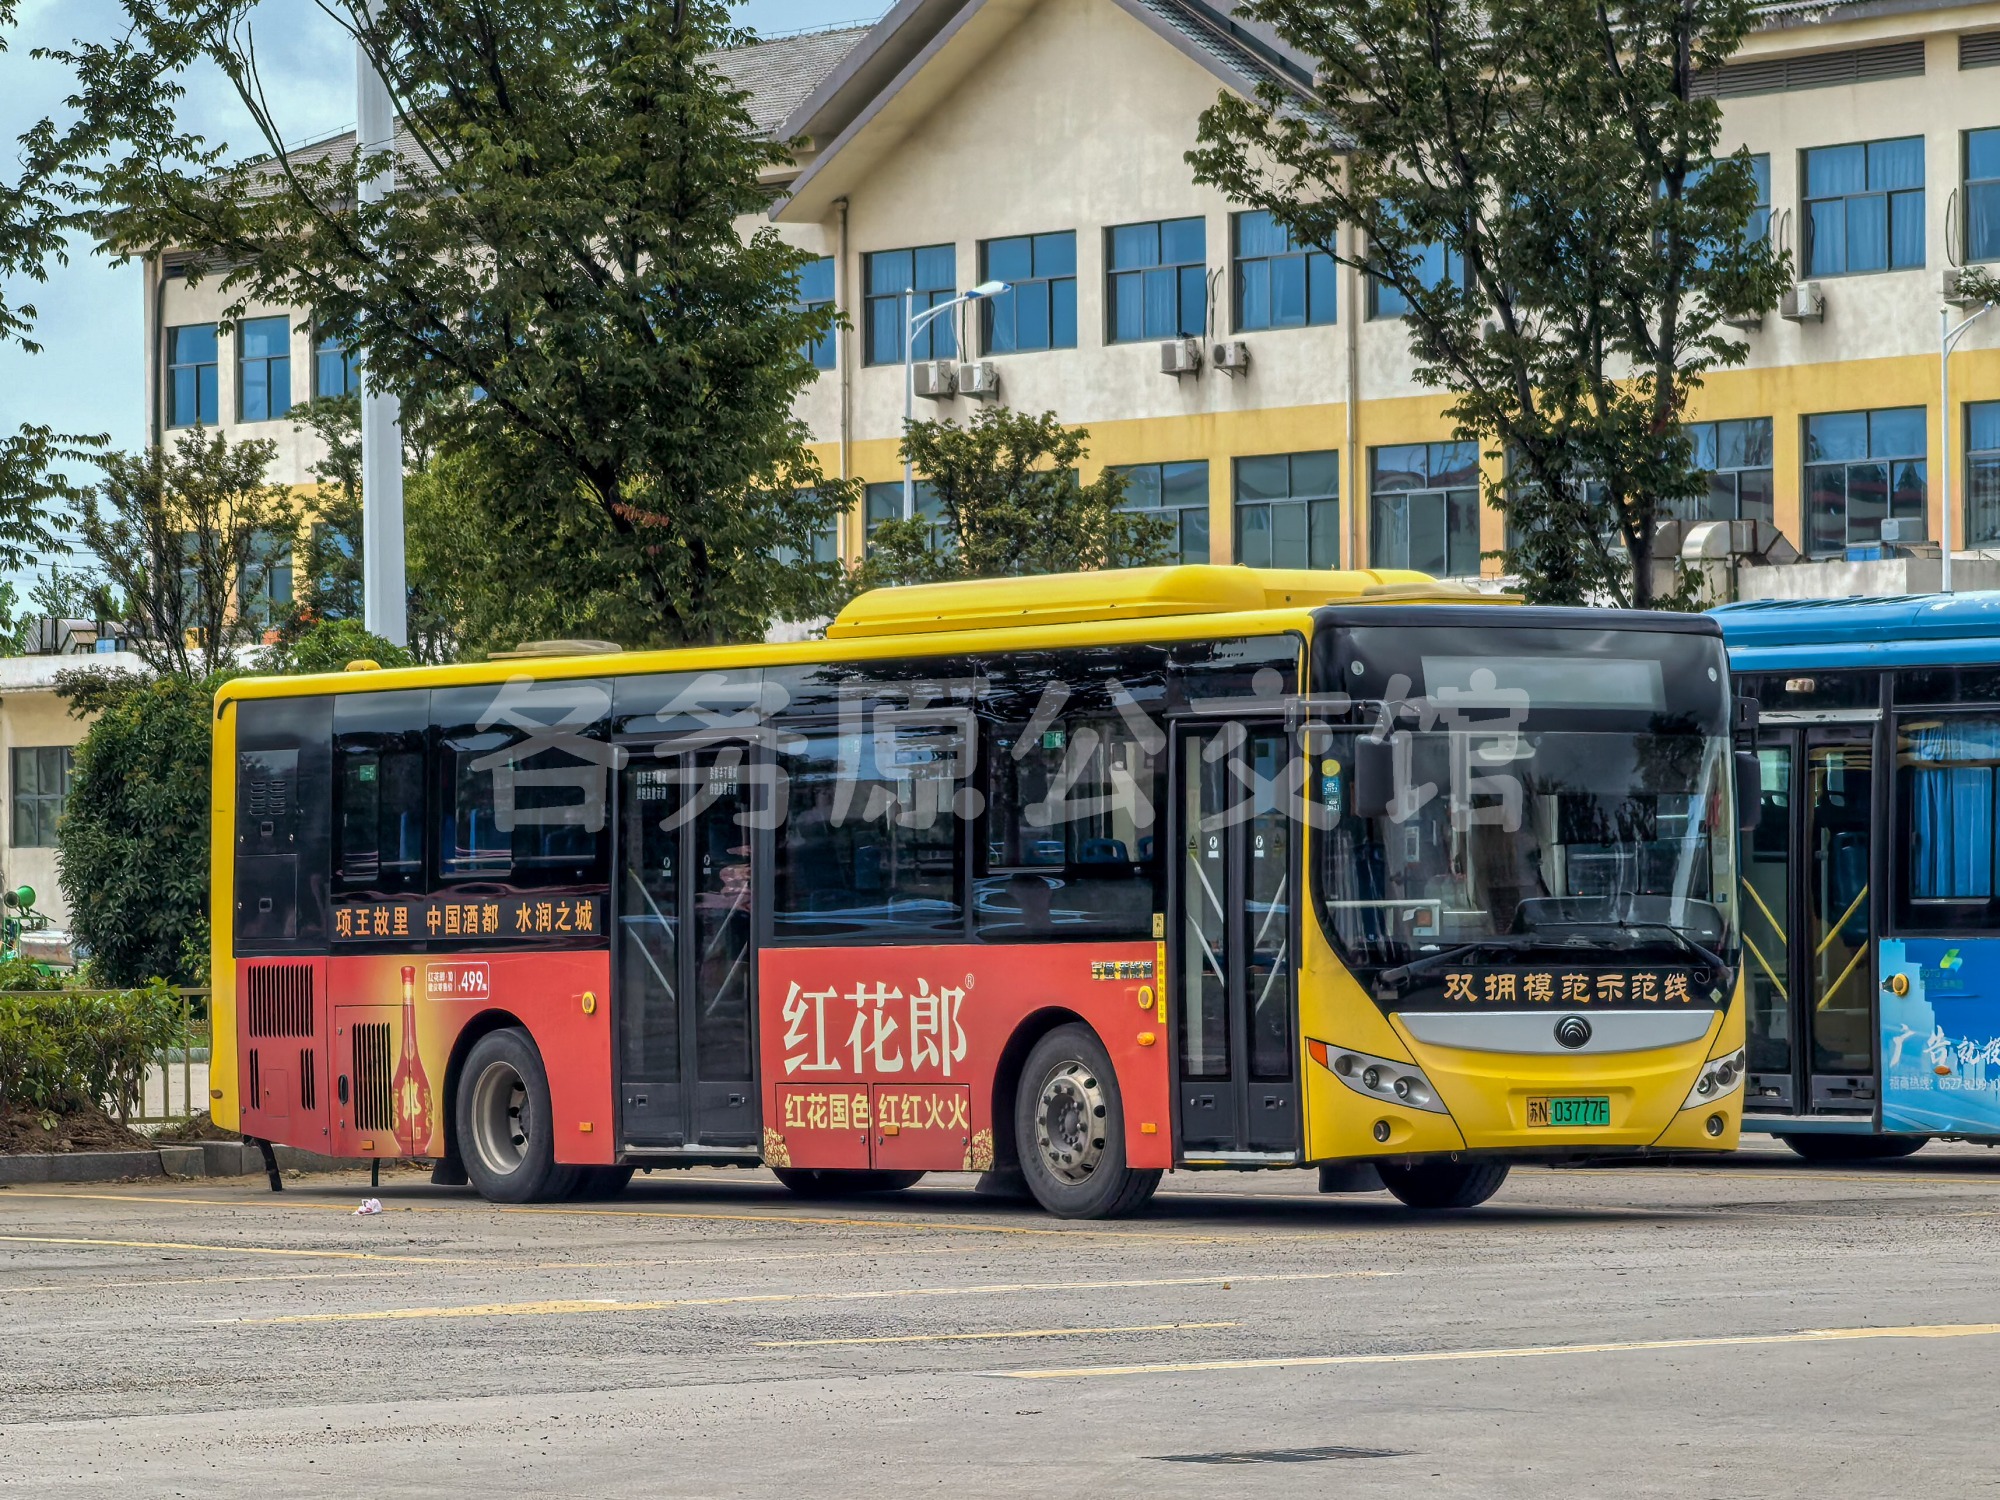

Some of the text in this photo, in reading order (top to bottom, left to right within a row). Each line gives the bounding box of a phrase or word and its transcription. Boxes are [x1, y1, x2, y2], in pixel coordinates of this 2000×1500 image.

[336, 900, 593, 937] 项王故里 中国酒都 水润之城
[1443, 972, 1690, 1003] 双拥模范示范线
[782, 977, 967, 1076] 红花郎
[784, 1092, 969, 1130] 红花国色 红红火火
